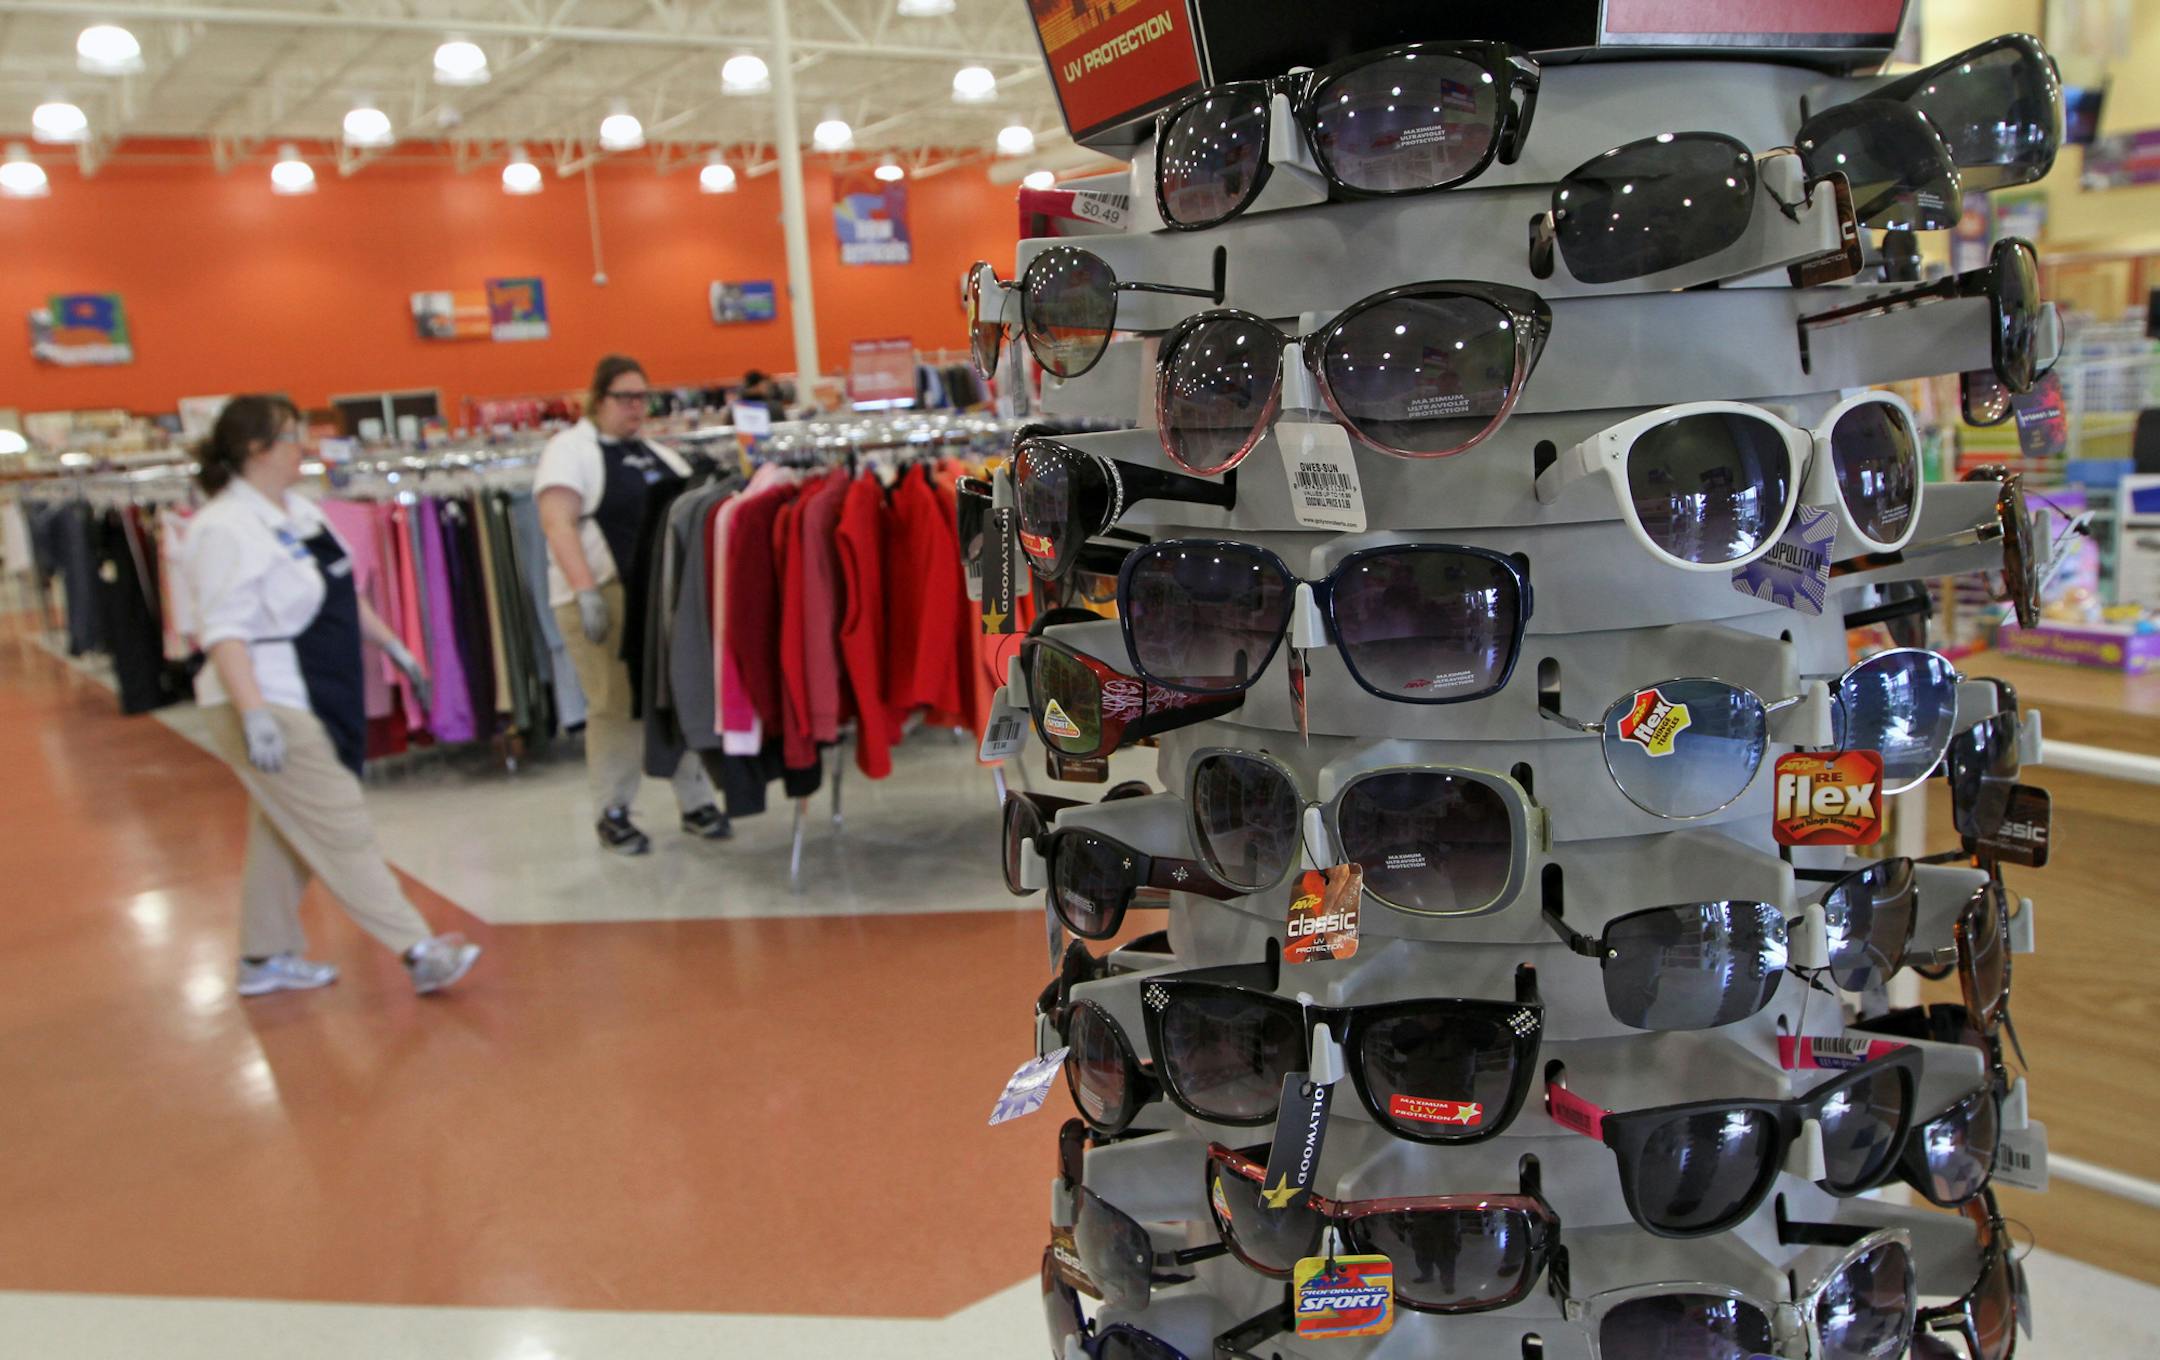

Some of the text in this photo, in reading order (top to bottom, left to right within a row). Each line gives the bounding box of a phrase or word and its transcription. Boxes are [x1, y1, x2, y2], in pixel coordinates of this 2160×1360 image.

[1063, 9, 1174, 83] UV PROTECTION
[1400, 130, 1446, 141] ULTRAVIOLET
[1403, 125, 1442, 135] MAXIMUM
[1401, 136, 1446, 147] PROTECTION
[1082, 200, 1120, 223] $0.49
[1411, 394, 1465, 405] MAXIMUM
[1407, 400, 1470, 412] ULTRAVIOLET
[1408, 406, 1469, 418] PROTECTION
[1299, 462, 1339, 473] GWES-SUN
[1001, 508, 1009, 613] HOLLYWOOD
[1633, 701, 1671, 743] flex
[1653, 717, 1671, 740] HINGE
[1657, 716, 1680, 746] TEMPLES
[1777, 757, 1820, 771] AMP
[1815, 772, 1843, 782] RE
[1777, 773, 1876, 821] flex
[1384, 857, 1426, 865] ULTRAVIOLET
[1388, 853, 1422, 861] MAXIMUM
[1387, 862, 1426, 870] PROTECTION
[1290, 893, 1322, 911] AMP
[1287, 907, 1357, 938] classic
[1313, 937, 1326, 946] UV
[1295, 942, 1345, 955] PROTECTION
[1400, 1097, 1449, 1109] MAXIMUM
[1395, 1109, 1450, 1121] PROTECTION
[1297, 1083, 1325, 1185] OLLYWOOD
[1300, 1286, 1387, 1297] PROFORMANCE
[1300, 1293, 1388, 1312] SPORT
